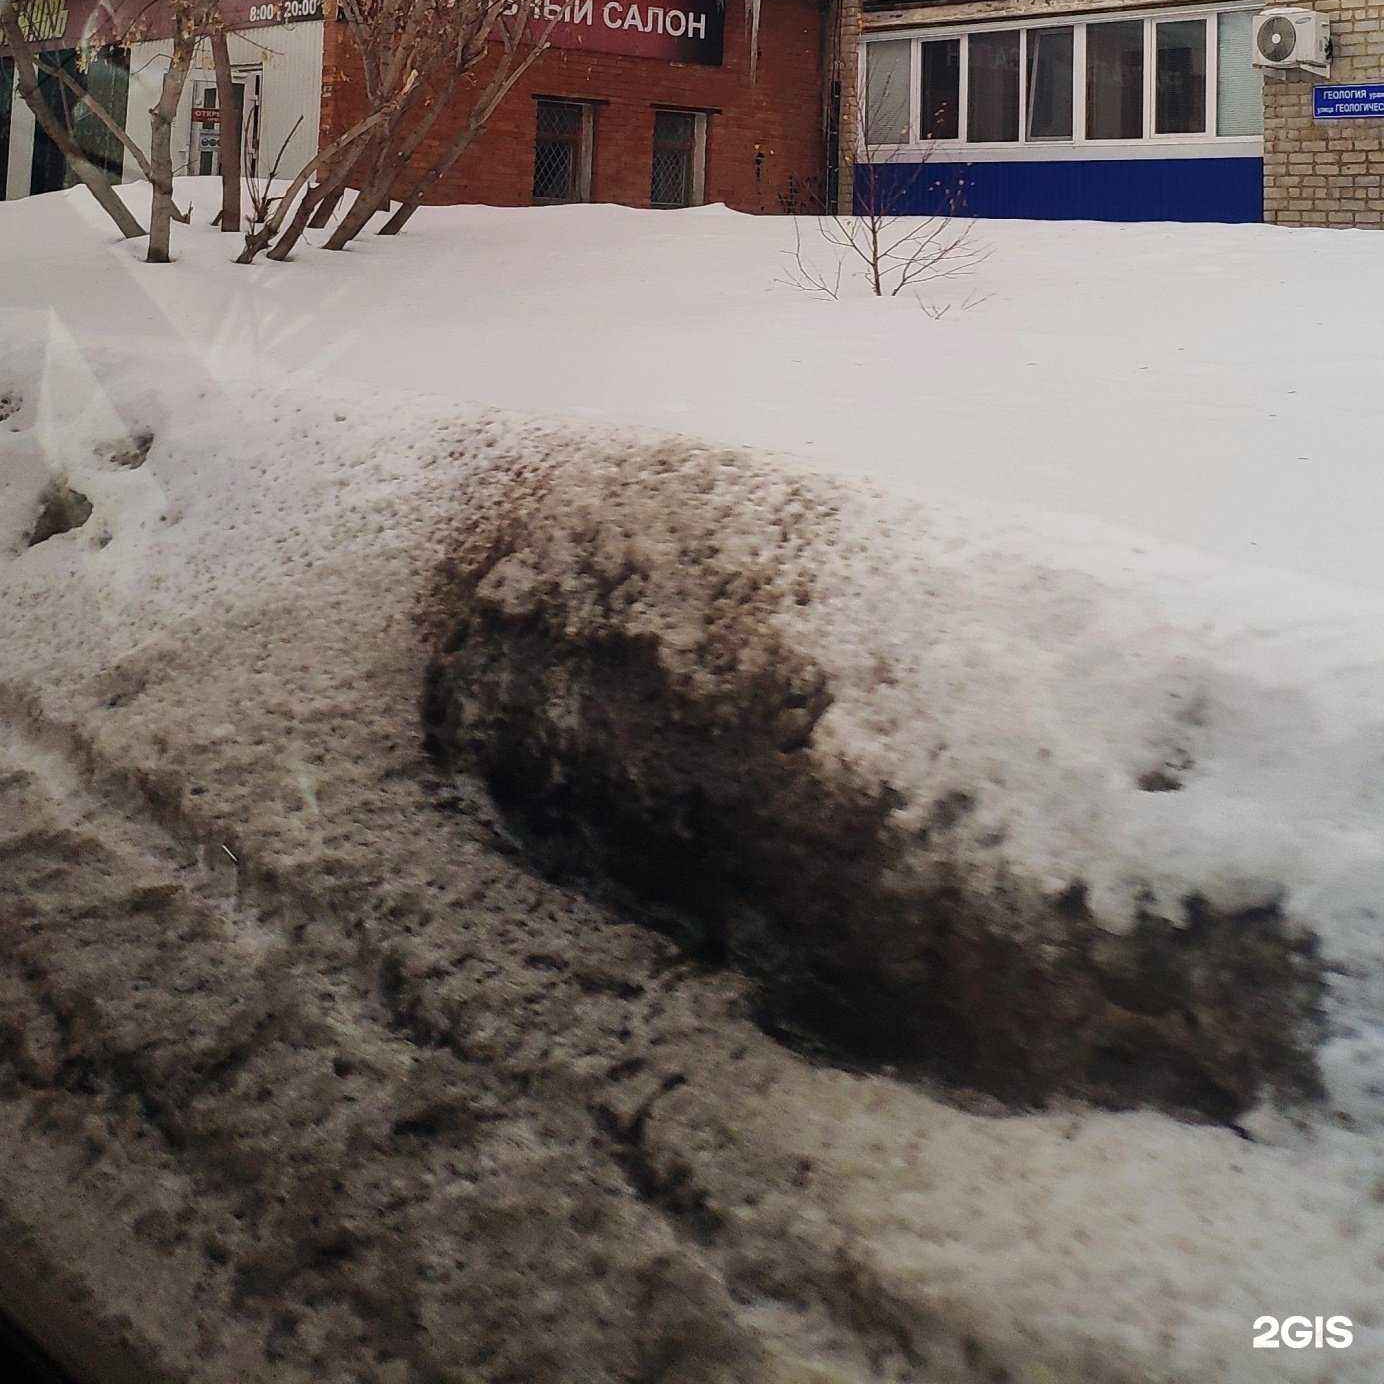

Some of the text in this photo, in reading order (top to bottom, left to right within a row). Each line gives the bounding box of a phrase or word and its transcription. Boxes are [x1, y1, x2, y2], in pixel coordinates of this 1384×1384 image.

[249, 3, 274, 22] 8:00
[604, 2, 706, 40] САЛОН
[1323, 89, 1367, 99] ГЕОЛОГИЯ
